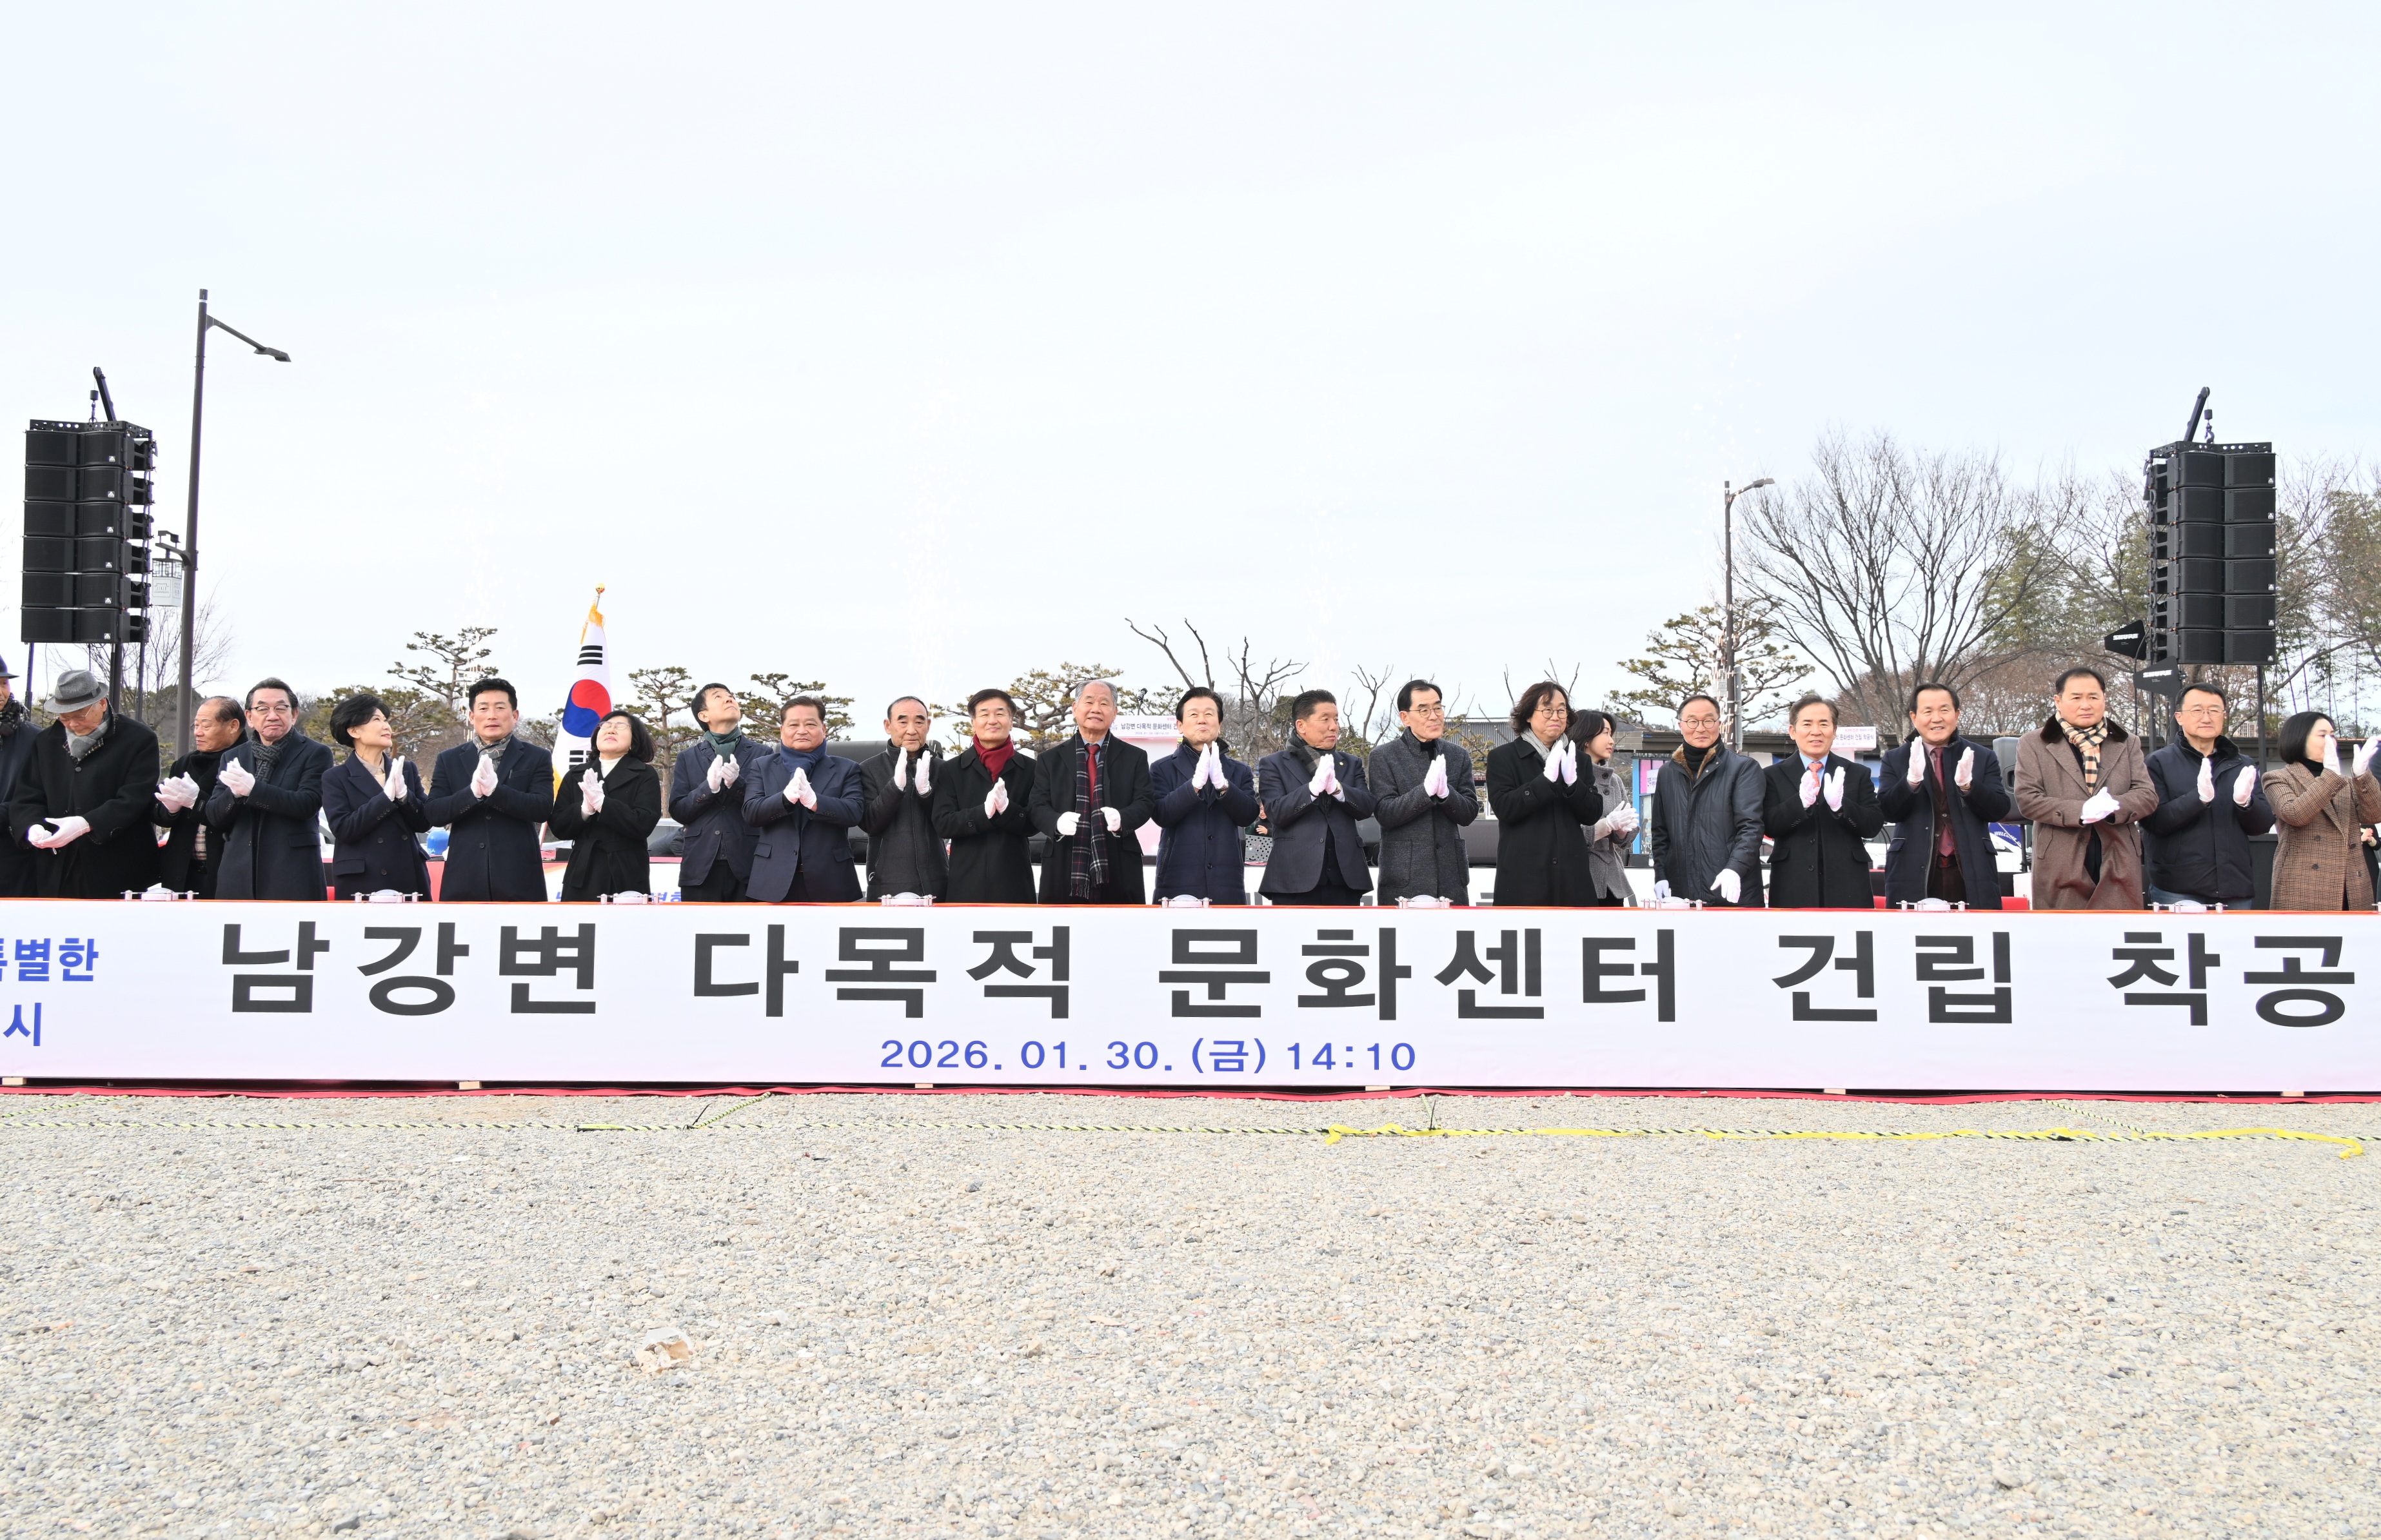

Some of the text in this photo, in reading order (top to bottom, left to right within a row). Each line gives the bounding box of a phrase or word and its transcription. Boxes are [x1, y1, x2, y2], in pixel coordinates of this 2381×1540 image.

[2142, 669, 2173, 678] SHURE
[0, 938, 99, 982] 별한
[222, 921, 2355, 1028] 남강변 다목적 문화센터 건립 착공
[3, 1002, 42, 1047] 시
[880, 1038, 1416, 1071] 2026. 01. 30. (금) 14:10
